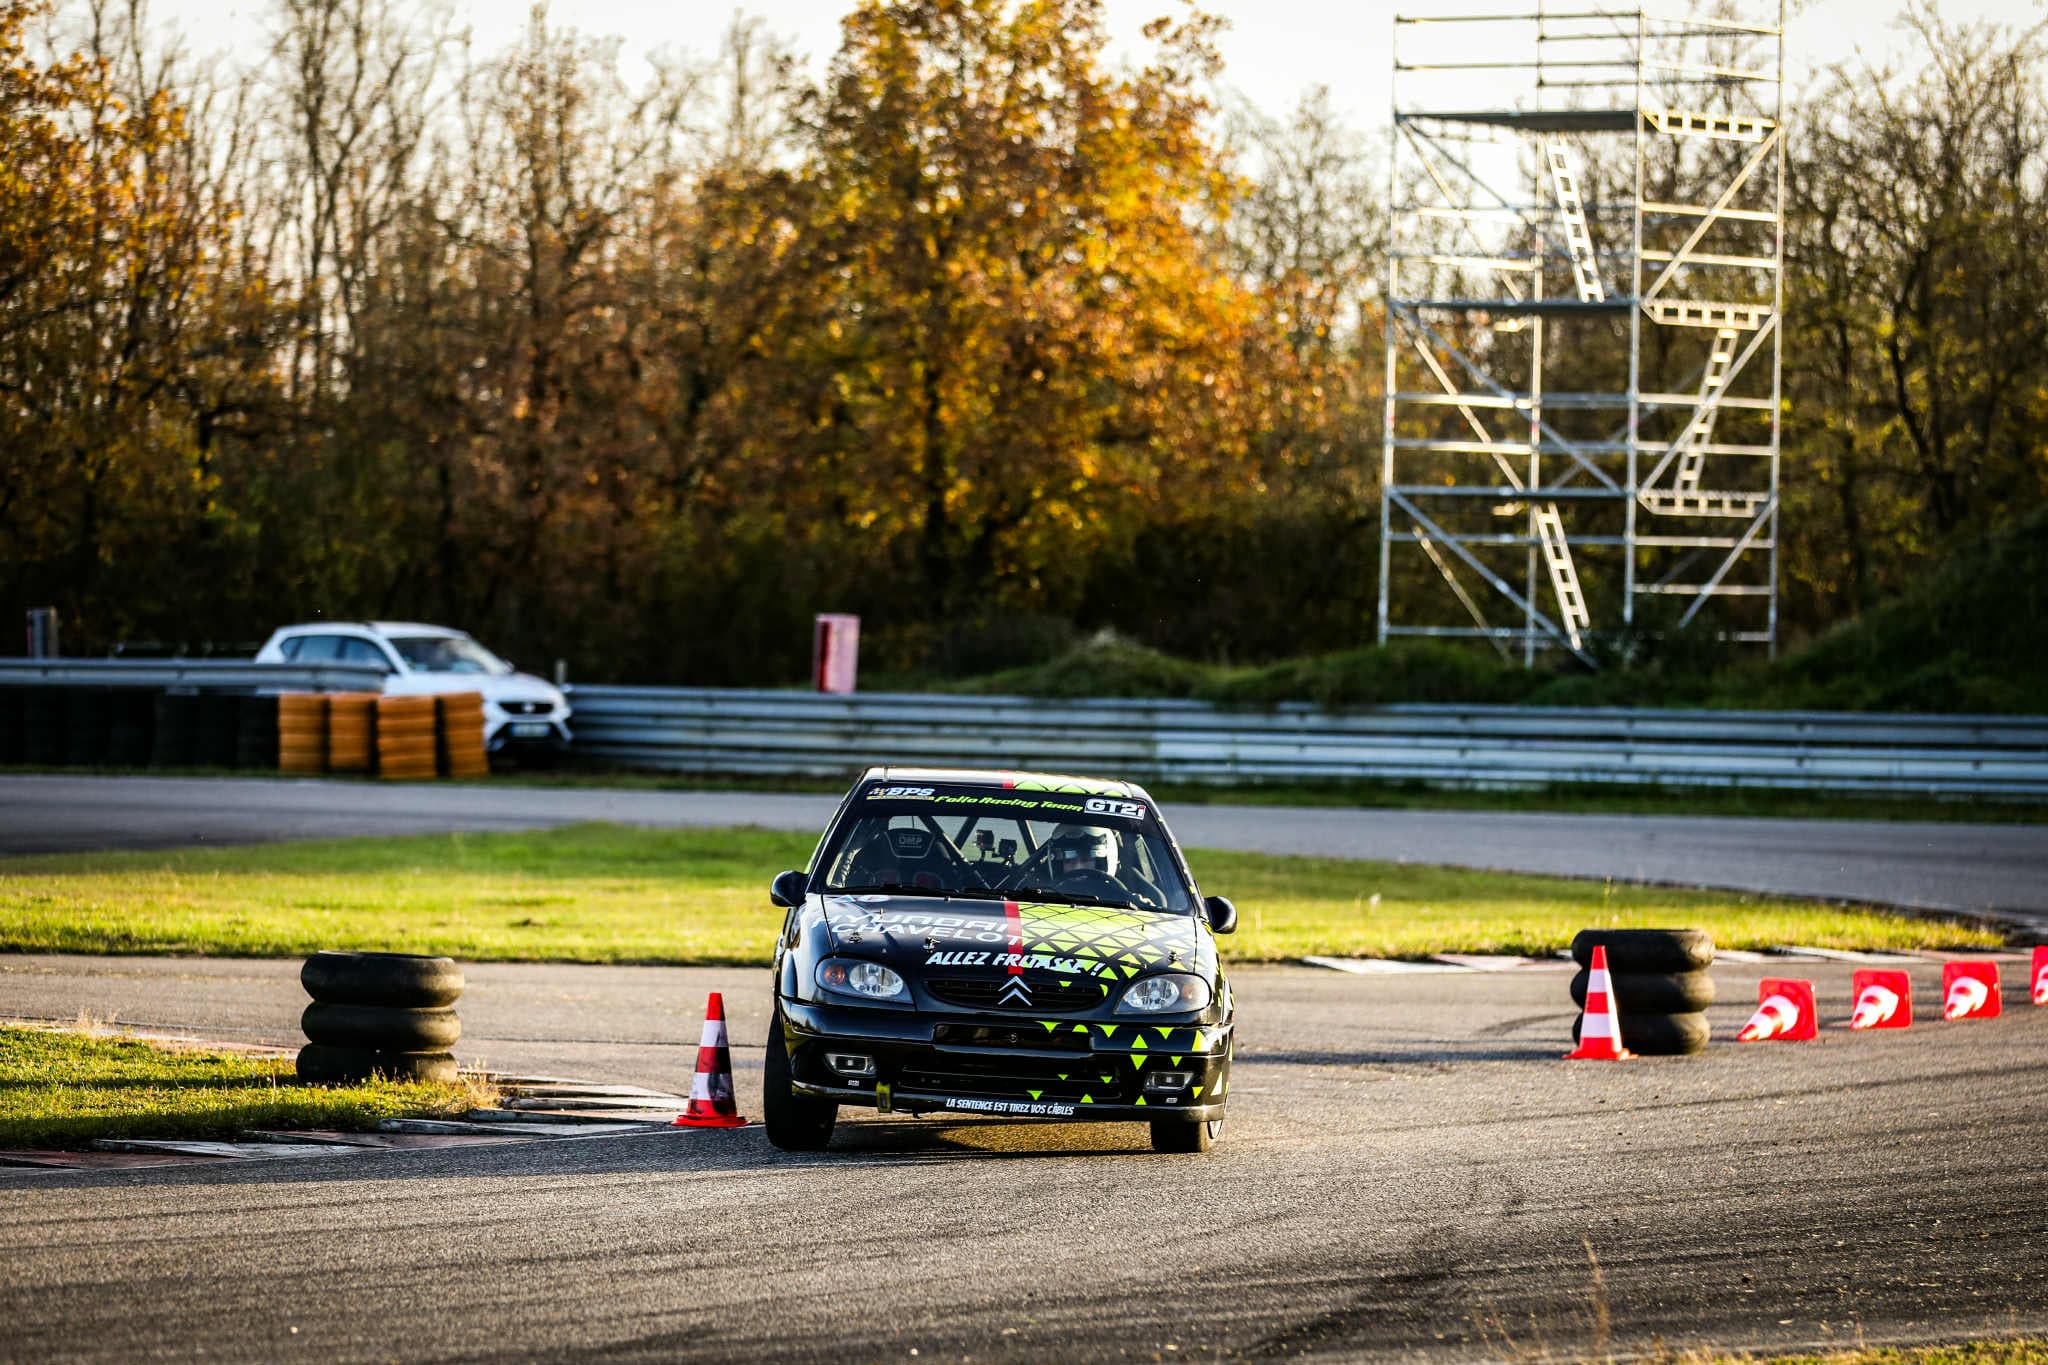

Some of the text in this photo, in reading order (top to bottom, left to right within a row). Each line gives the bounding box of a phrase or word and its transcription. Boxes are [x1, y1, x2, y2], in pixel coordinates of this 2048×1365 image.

[1086, 799, 1147, 817] GT2i
[832, 923, 1024, 946] CHAVELOT
[925, 951, 991, 966] ALLEZ
[946, 1098, 957, 1108] LA
[956, 1099, 994, 1111] SENTENCE
[994, 1102, 1009, 1112] EST
[1009, 1103, 1030, 1113] TIREZ
[1030, 1104, 1047, 1114] VOS
